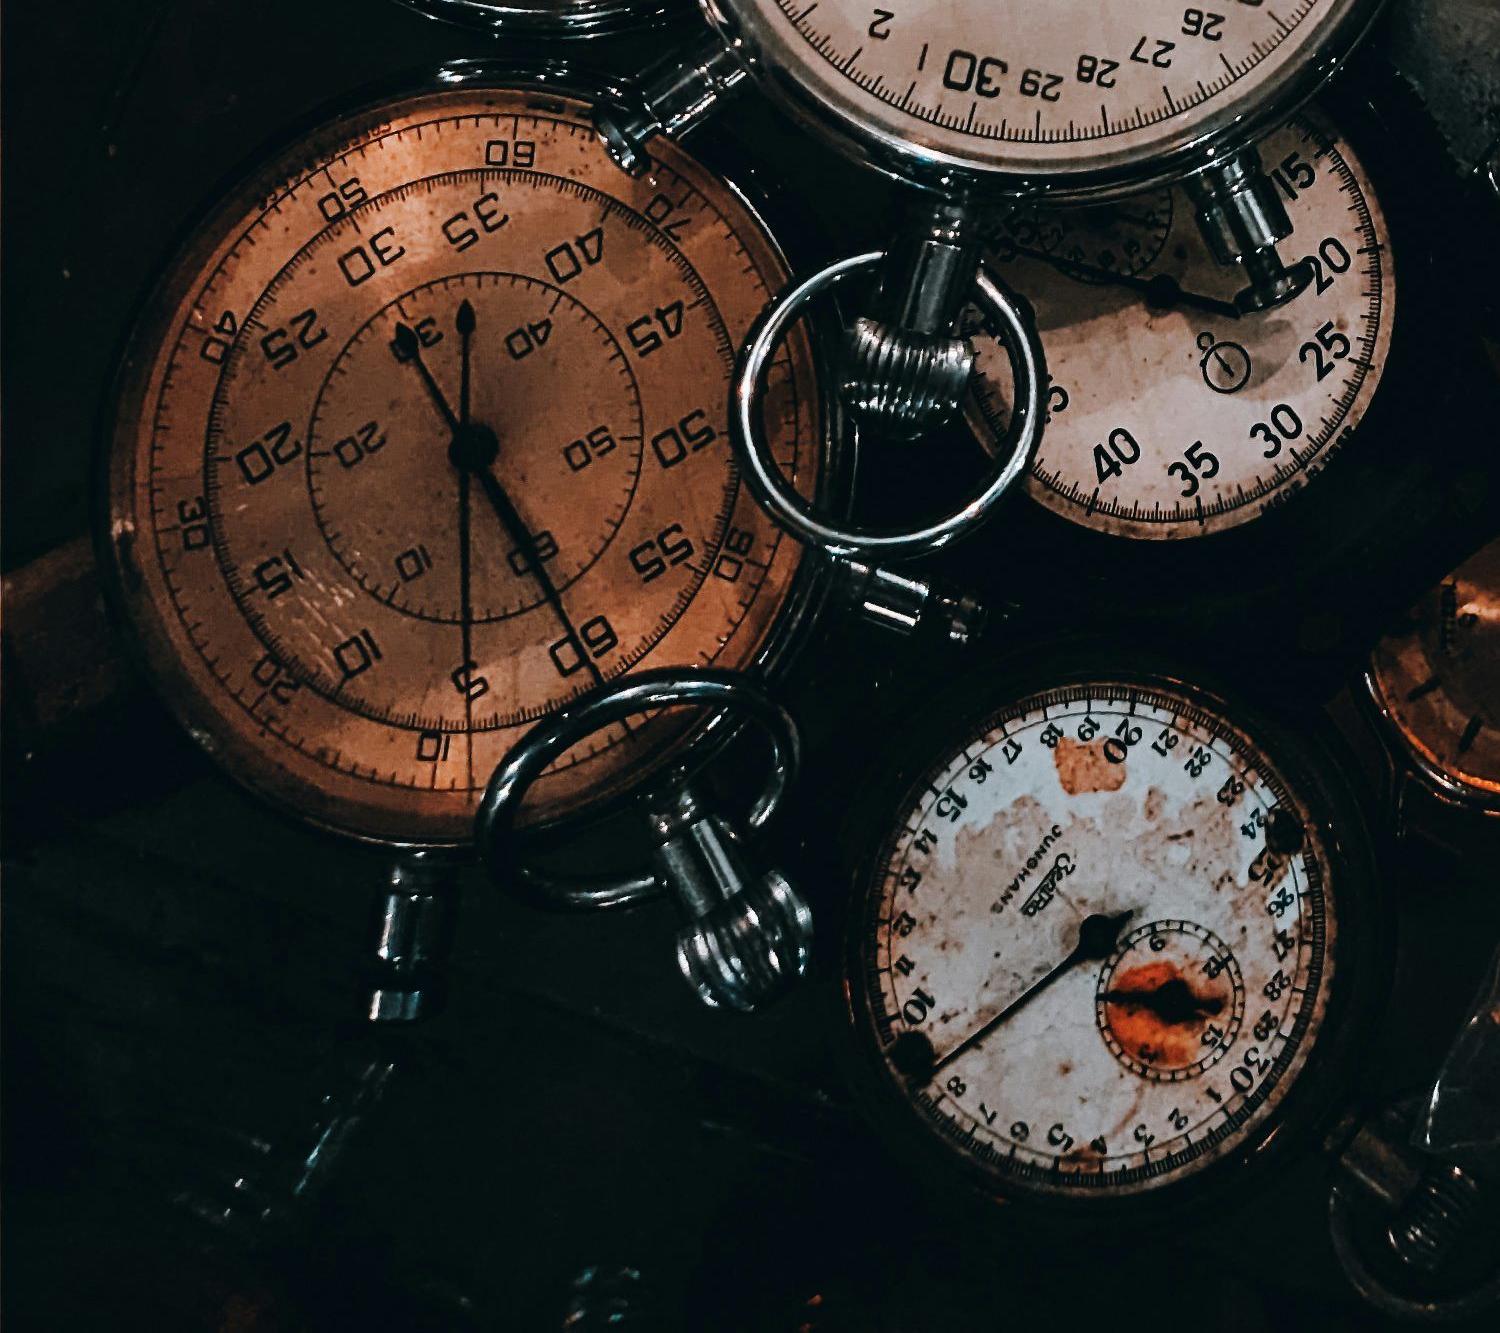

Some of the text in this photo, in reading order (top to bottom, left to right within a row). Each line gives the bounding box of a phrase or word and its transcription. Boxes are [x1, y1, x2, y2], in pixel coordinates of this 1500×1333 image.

[867, 8, 896, 41] 2
[1181, 8, 1227, 41] 26
[917, 43, 929, 71] 1
[941, 49, 1009, 99] 30
[1076, 55, 1121, 89] 28
[1129, 34, 1177, 69] 27
[1017, 67, 1065, 102] 29
[486, 139, 534, 169] 60
[1269, 152, 1316, 201] 15
[317, 177, 369, 223] 50
[441, 193, 509, 252] 35
[646, 194, 692, 242] 70
[337, 226, 406, 287] 30
[545, 229, 603, 285] 40
[200, 309, 238, 366] 40
[260, 308, 327, 370] 25
[505, 317, 553, 359] 40
[626, 301, 684, 355] 45
[1299, 321, 1351, 382] 25
[236, 422, 301, 485] 20
[339, 422, 387, 469] 20
[564, 425, 615, 473] 50
[651, 409, 717, 469] 50
[1250, 403, 1303, 459] 30
[1093, 428, 1140, 484] 40
[1167, 441, 1219, 497] 35
[253, 549, 304, 599] 15
[396, 544, 431, 582] 10
[629, 523, 694, 583] 55
[333, 630, 382, 678] 10
[549, 615, 619, 676] 60
[417, 734, 450, 761] 10
[1001, 740, 1023, 765] 17
[1040, 721, 1064, 750] 18
[1076, 716, 1100, 743] 19
[1102, 718, 1143, 765] 20
[1151, 730, 1179, 757] 21
[968, 757, 993, 785] 16
[1184, 745, 1212, 778] 22
[935, 790, 968, 823] 15
[914, 828, 938, 855] 14
[991, 824, 1063, 915] JUNGHANS
[902, 988, 936, 1027] 10
[946, 1075, 967, 1098] 8
[1229, 1046, 1272, 1093] 30
[978, 1103, 997, 1126] 7
[1047, 1123, 1073, 1152] 5
[1168, 1108, 1189, 1130] 2
